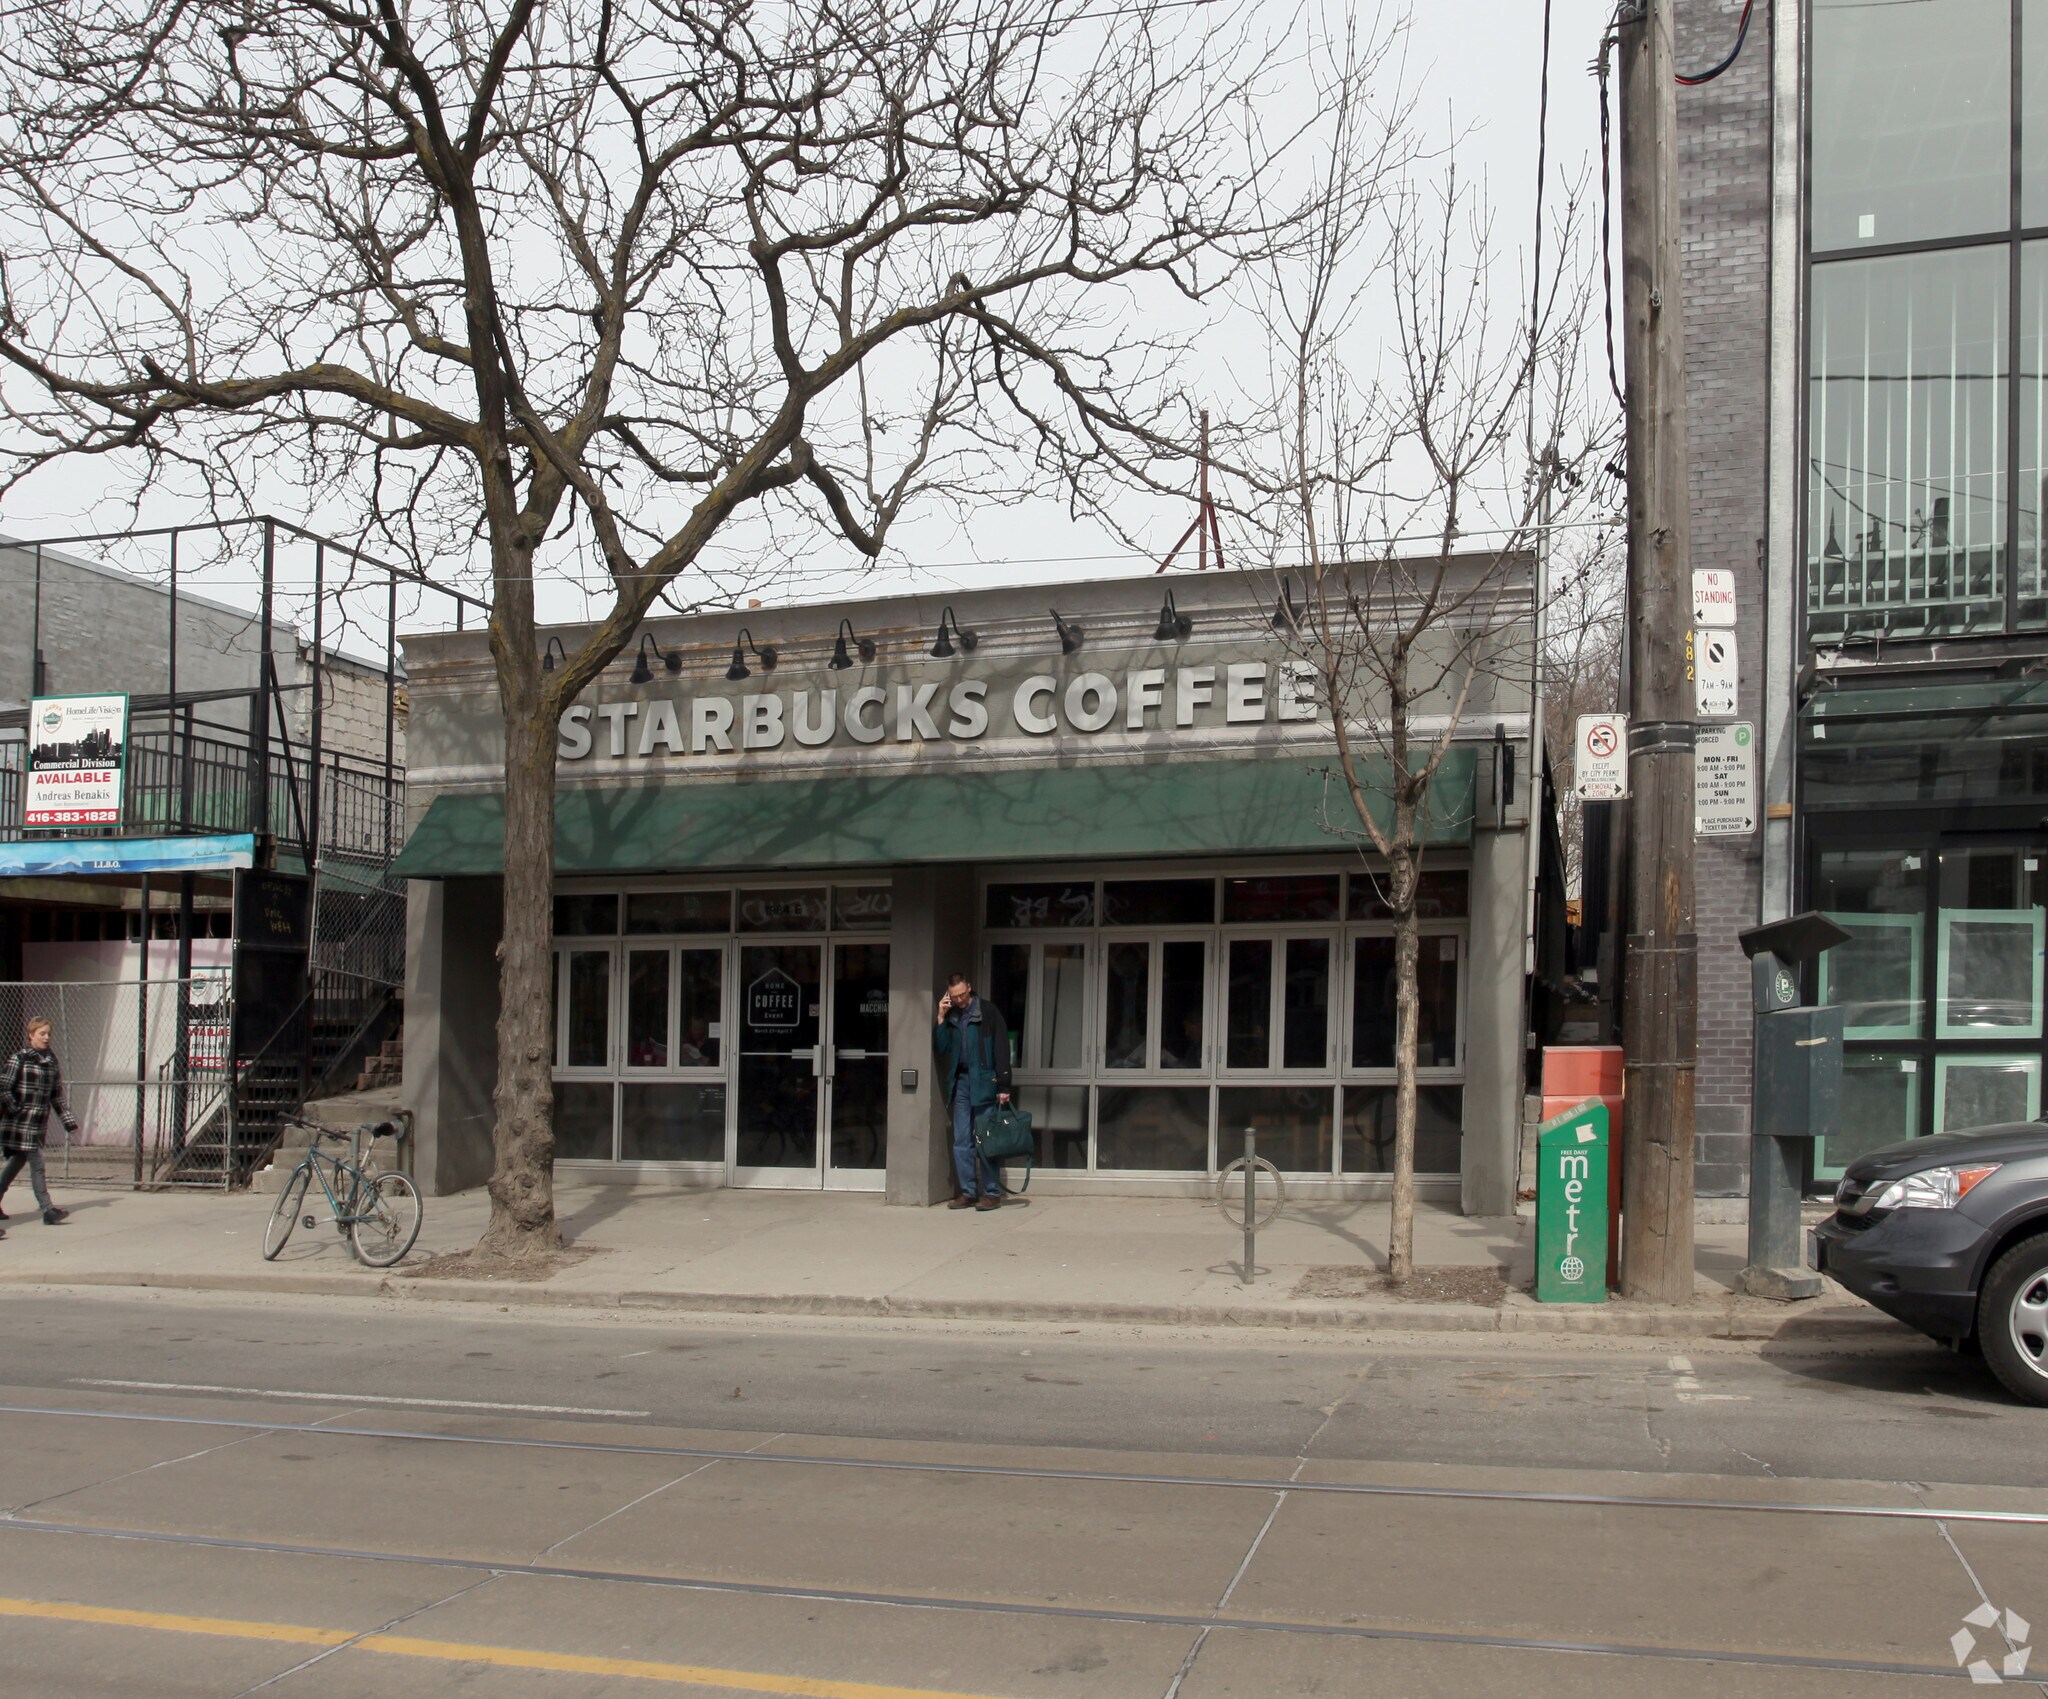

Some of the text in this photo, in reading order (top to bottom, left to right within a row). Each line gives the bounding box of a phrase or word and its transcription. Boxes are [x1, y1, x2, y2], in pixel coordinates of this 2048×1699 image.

[1708, 573, 1718, 585] NO
[1695, 590, 1732, 603] STANDING
[1702, 679, 1714, 689] 7AM
[1720, 679, 1733, 689] 9AM
[558, 660, 1318, 759] STARBUCKS COFFEE
[1739, 732, 1746, 741] P
[34, 758, 116, 769] Commercial Division
[36, 772, 111, 784] AVAILABLE
[36, 789, 110, 801] Andreas Benakis
[28, 812, 116, 822] 416-383-1828
[1782, 978, 1789, 990] P
[755, 995, 793, 1008] COFFEE
